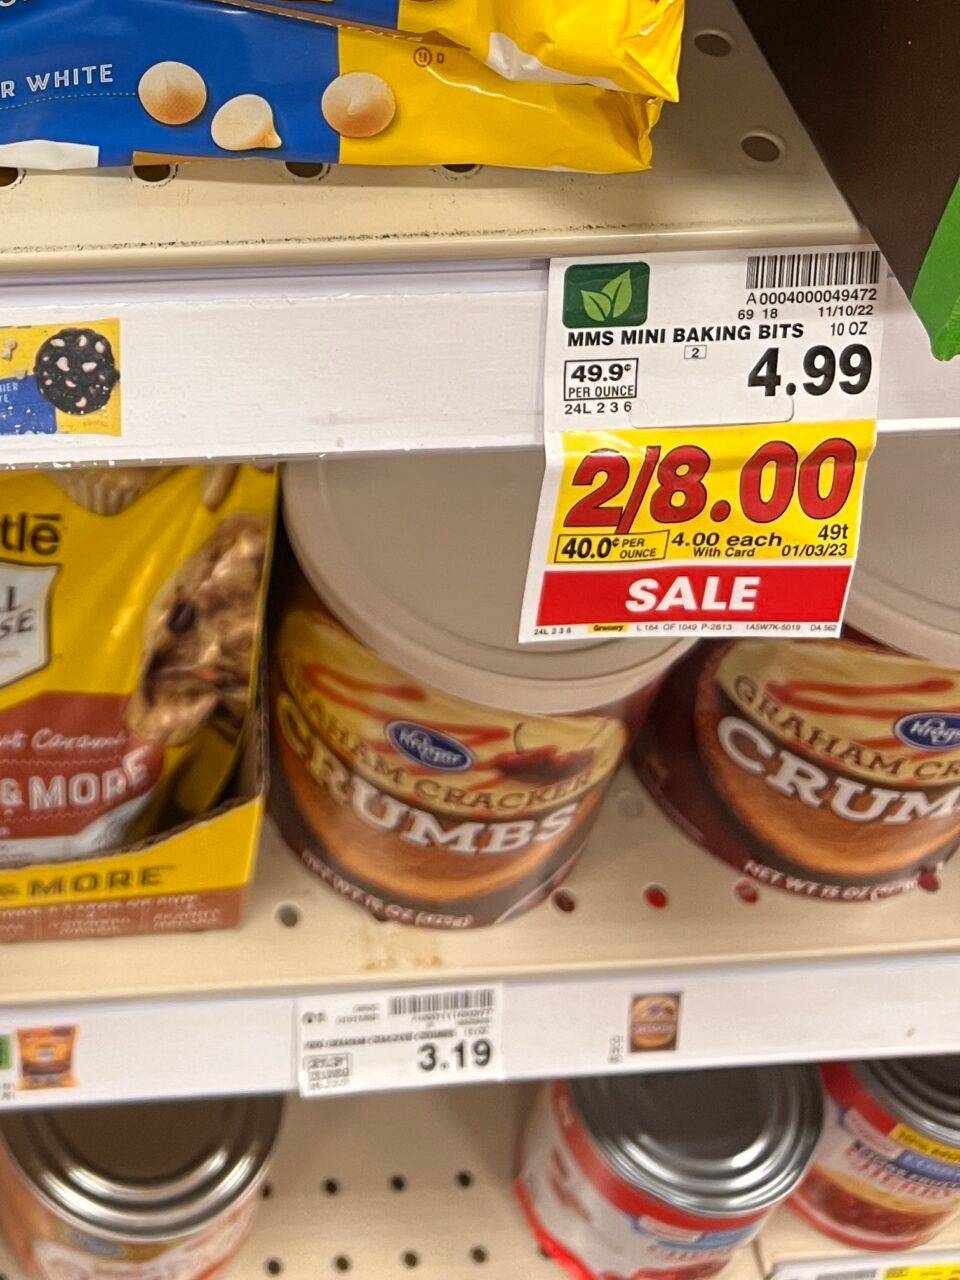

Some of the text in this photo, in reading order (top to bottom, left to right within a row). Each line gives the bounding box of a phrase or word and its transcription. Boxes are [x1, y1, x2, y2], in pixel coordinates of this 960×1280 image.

[26, 64, 114, 90] WHITE
[738, 307, 778, 320] 69 18
[818, 305, 873, 317] 11/10/22
[568, 322, 867, 347] MMS MINI BAKING BITS 10 OZ
[747, 344, 872, 397] 4.99
[568, 385, 635, 398] PER OUNCE
[564, 403, 592, 414] 24L
[563, 438, 856, 534] 2/8.00
[622, 538, 645, 547] PER
[672, 532, 782, 547] 4.00 each
[693, 546, 755, 558] With Card
[781, 544, 848, 556] 01/03/23
[620, 548, 656, 558] OUNCE
[625, 576, 760, 612] SALE
[734, 675, 907, 775] GRAHAM
[398, 728, 462, 764] Kroger
[276, 693, 580, 855] CRUMBS
[717, 716, 960, 825] CRUM
[414, 774, 591, 812] CRACKER
[418, 1039, 491, 1072] 3.19
